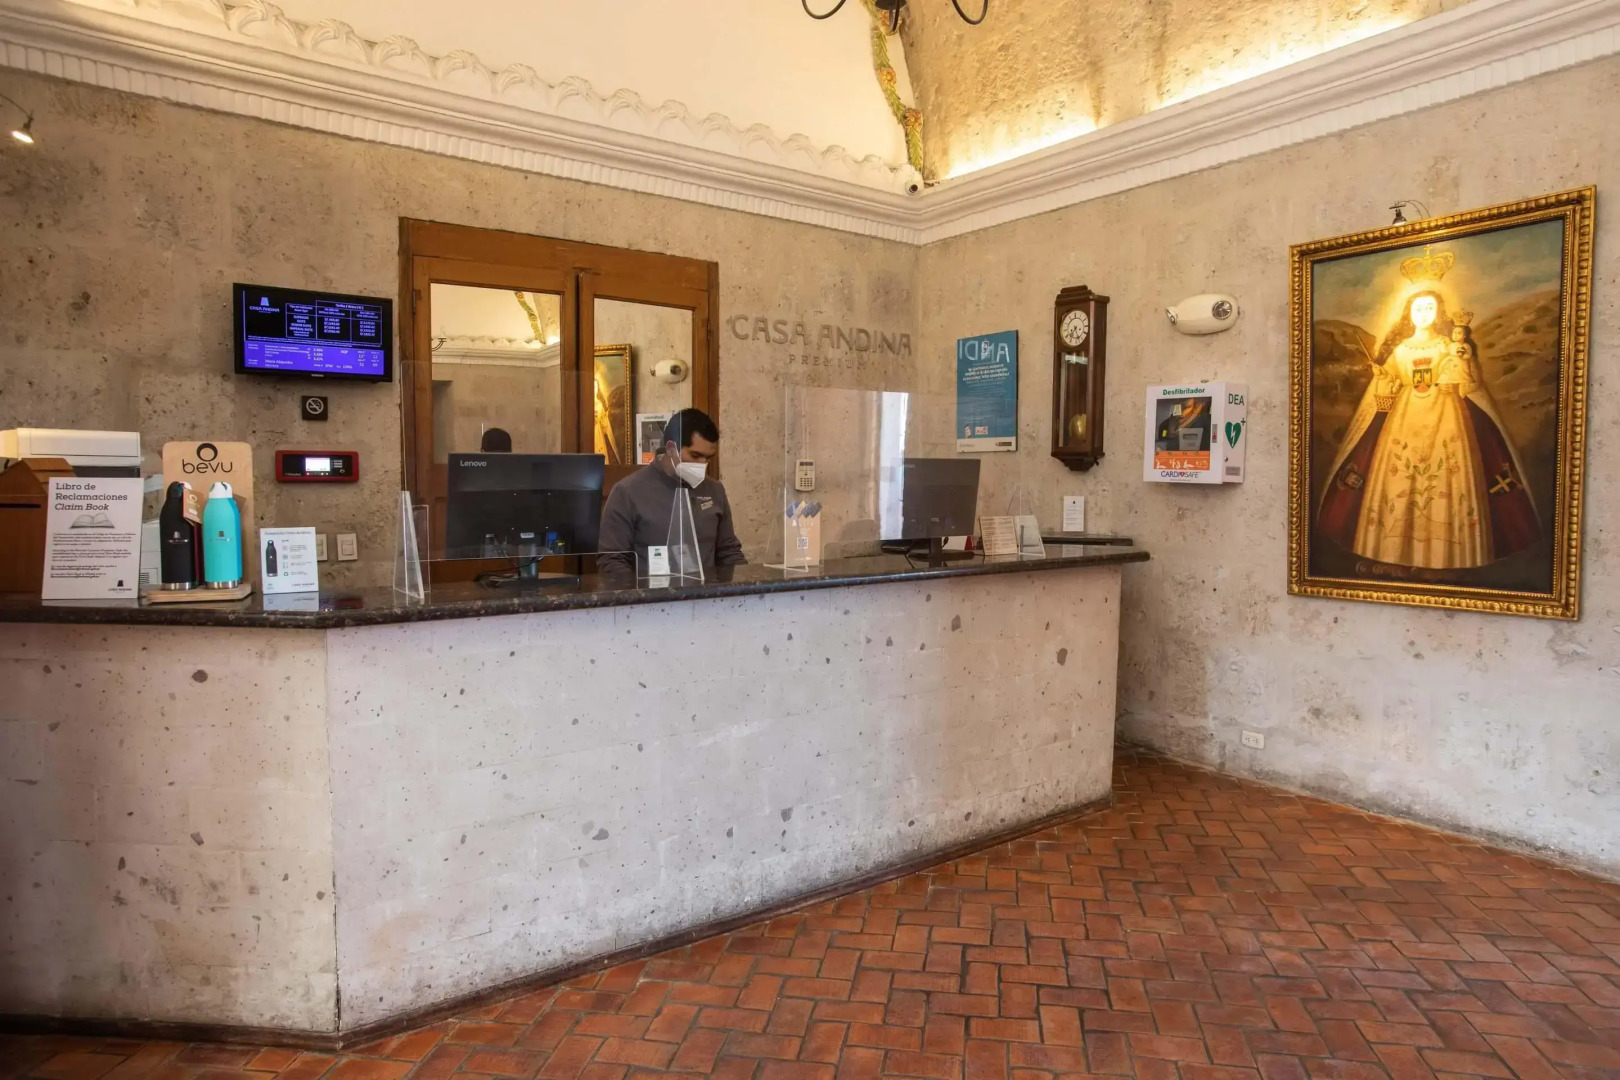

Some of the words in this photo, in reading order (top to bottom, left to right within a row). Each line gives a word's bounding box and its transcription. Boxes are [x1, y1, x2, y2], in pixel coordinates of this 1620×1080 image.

[730, 314, 808, 346] CASA
[817, 324, 912, 356] ANDINA
[788, 354, 867, 370] PREMIUM
[1162, 388, 1205, 396] Desfibrilador
[1228, 393, 1245, 406] DEA
[182, 458, 233, 474] bevu
[55, 482, 82, 490] Libro
[84, 482, 96, 490] de
[55, 493, 128, 501] Reclamaciones
[55, 503, 83, 511] Claim
[85, 503, 109, 511] Book
